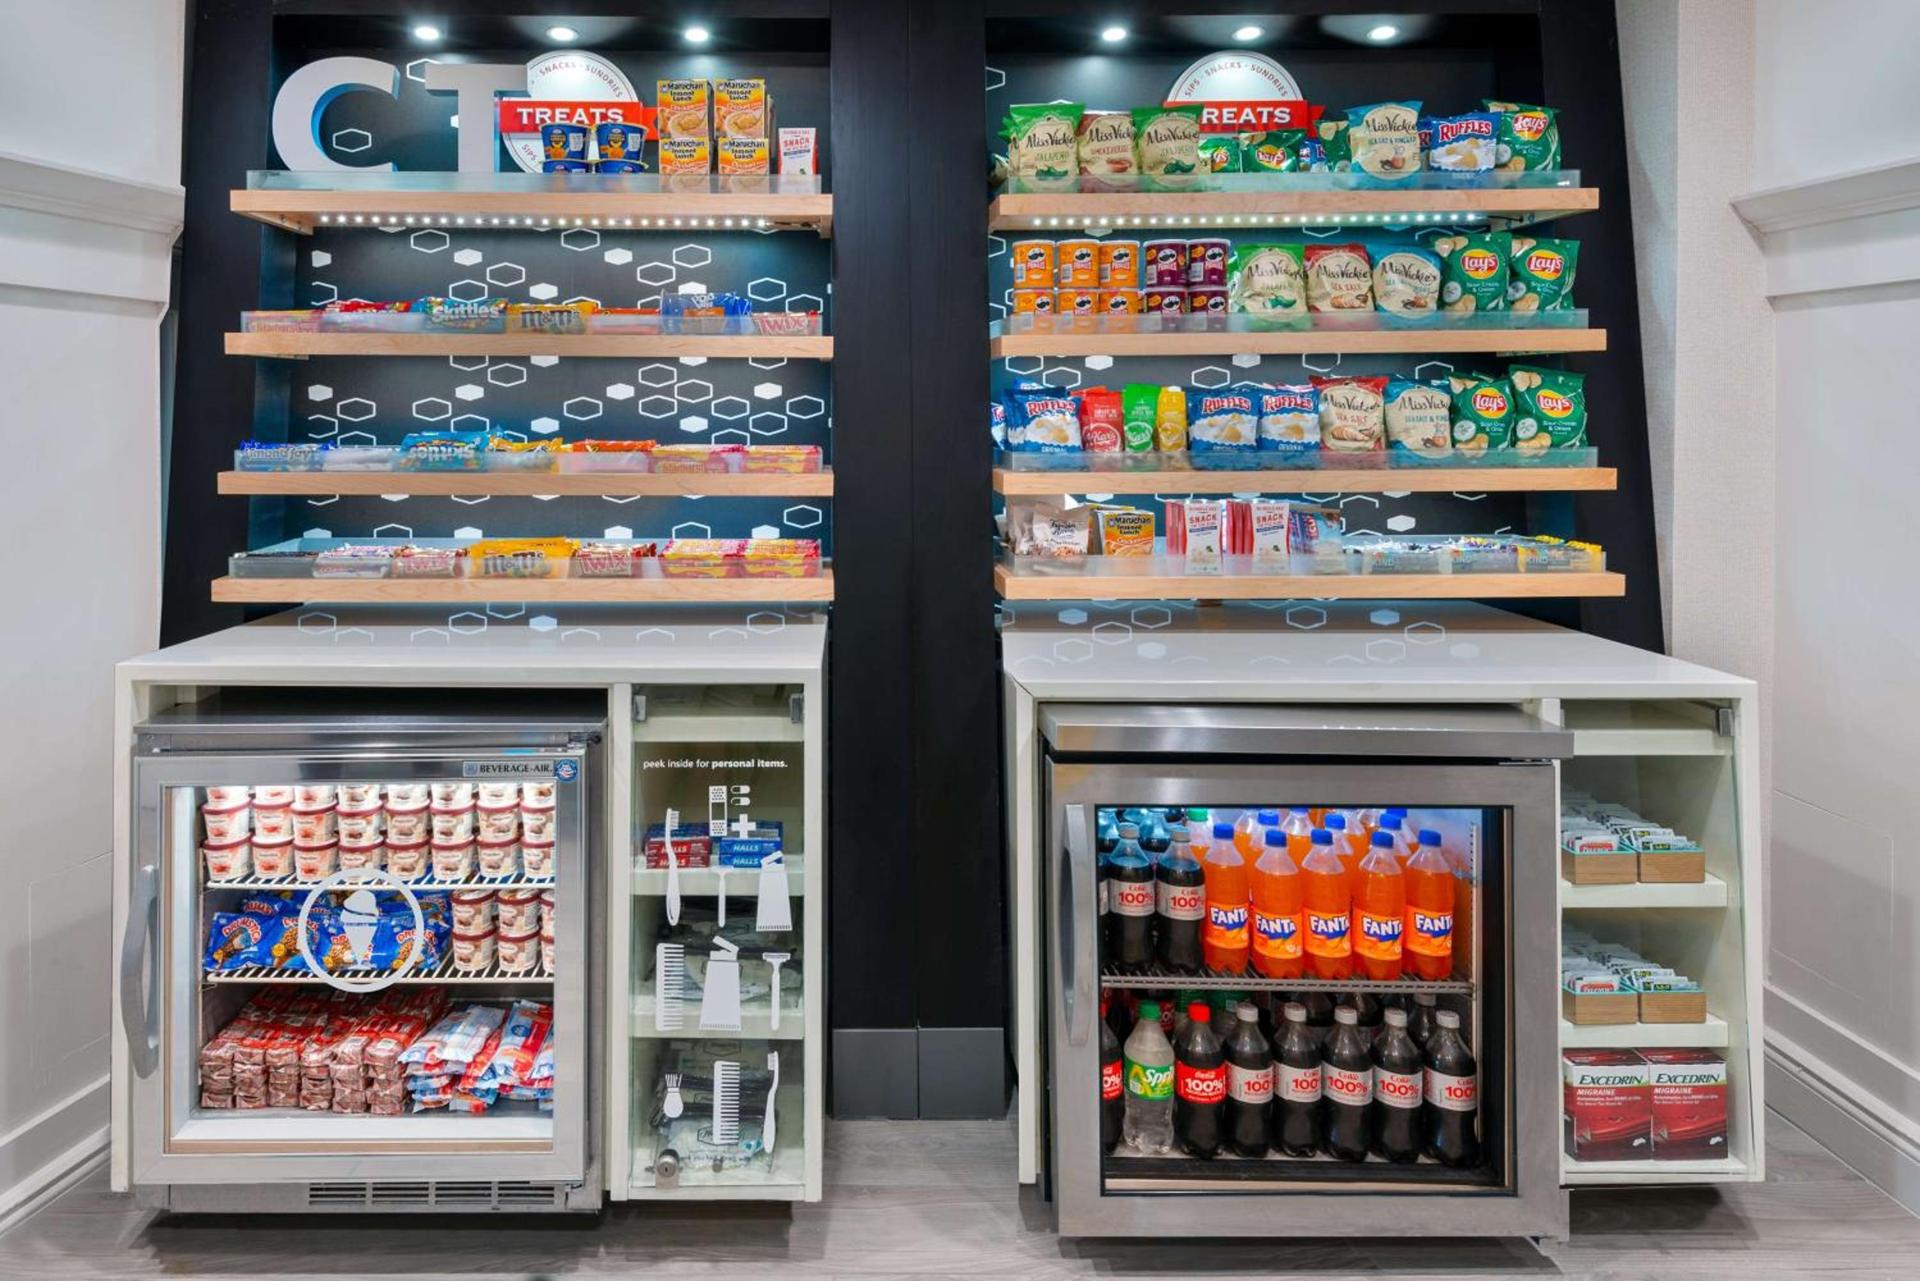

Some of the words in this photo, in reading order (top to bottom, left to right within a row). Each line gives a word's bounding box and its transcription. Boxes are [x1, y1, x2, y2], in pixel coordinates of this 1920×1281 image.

[539, 61, 577, 77] SNACKS
[585, 64, 623, 98] SUNDRIES
[667, 81, 704, 91] Maruchan
[724, 81, 760, 90] Maruchan
[1184, 79, 1201, 97] SIPS
[1205, 61, 1242, 77] SNACKS
[1250, 64, 1288, 98] SUNDRIES
[516, 107, 624, 125] TREATS
[1201, 107, 1291, 125] REATS
[1088, 128, 1114, 144] Miss
[1439, 119, 1493, 141] RUFFLES
[669, 140, 705, 148] Maruchan
[728, 140, 765, 148] Maruchan
[1025, 133, 1050, 149] Miss
[1146, 131, 1173, 147] Miss
[520, 143, 538, 162] SIPS
[1463, 252, 1497, 272] Lay's
[1530, 254, 1563, 272] Lay's
[1316, 263, 1341, 279] Miss
[432, 303, 500, 322] Skittles
[1026, 400, 1076, 417] RUFFLES
[1203, 397, 1251, 413] RUFFLES
[1263, 395, 1313, 412] RUFFLES
[1400, 396, 1427, 412] Miss
[1474, 394, 1506, 412] Lay's
[1539, 396, 1573, 413] Lay's
[1115, 517, 1151, 525] Maruchan
[1189, 513, 1217, 524] SNACK
[1256, 513, 1284, 524] SNACK
[643, 759, 666, 770] peek
[667, 759, 694, 768] inside
[695, 759, 709, 768] for
[711, 758, 755, 770] personal
[757, 758, 788, 768] items.
[733, 857, 759, 865] HALLS
[1414, 912, 1452, 931] FANT
[1145, 1066, 1175, 1087] Spri
[1292, 1078, 1319, 1090] 100
[1328, 1076, 1368, 1093] 100%
[1579, 1074, 1643, 1085] EXCEDRIN
[1655, 1073, 1720, 1084] EXCEDRIN
[1185, 1078, 1224, 1093] 100%
[1244, 1080, 1270, 1092] 100
[1378, 1079, 1419, 1096] 100%
[1445, 1085, 1475, 1099] 100
[1576, 1088, 1616, 1096] MIGRAINE
[1653, 1087, 1693, 1095] MIGRAINE
